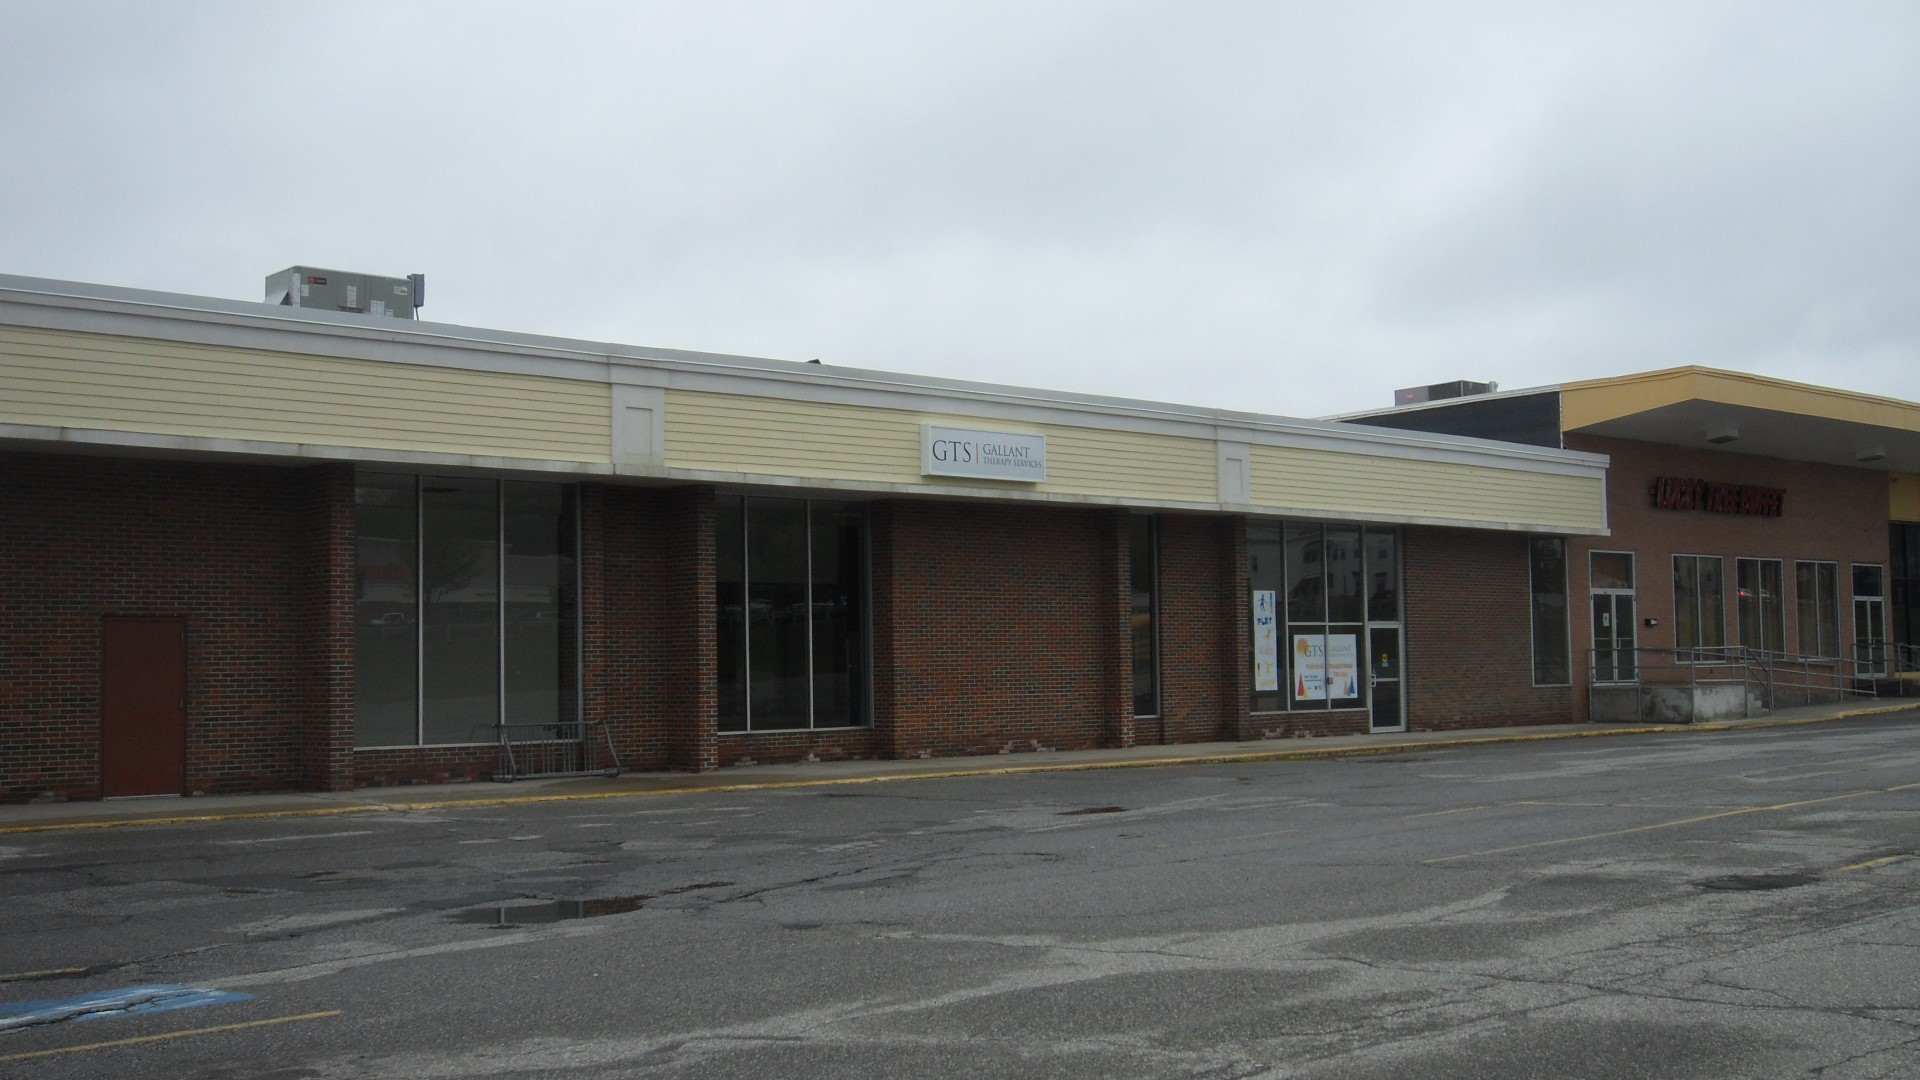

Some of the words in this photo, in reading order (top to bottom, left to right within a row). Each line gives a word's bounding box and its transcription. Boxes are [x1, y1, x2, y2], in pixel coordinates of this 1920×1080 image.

[932, 439, 972, 463] GTS
[982, 443, 1030, 458] GALLANT
[983, 456, 1011, 466] THERAPY
[1013, 459, 1042, 468] SERVICES
[1257, 617, 1273, 625] PLAY
[1304, 645, 1324, 657] GTS
